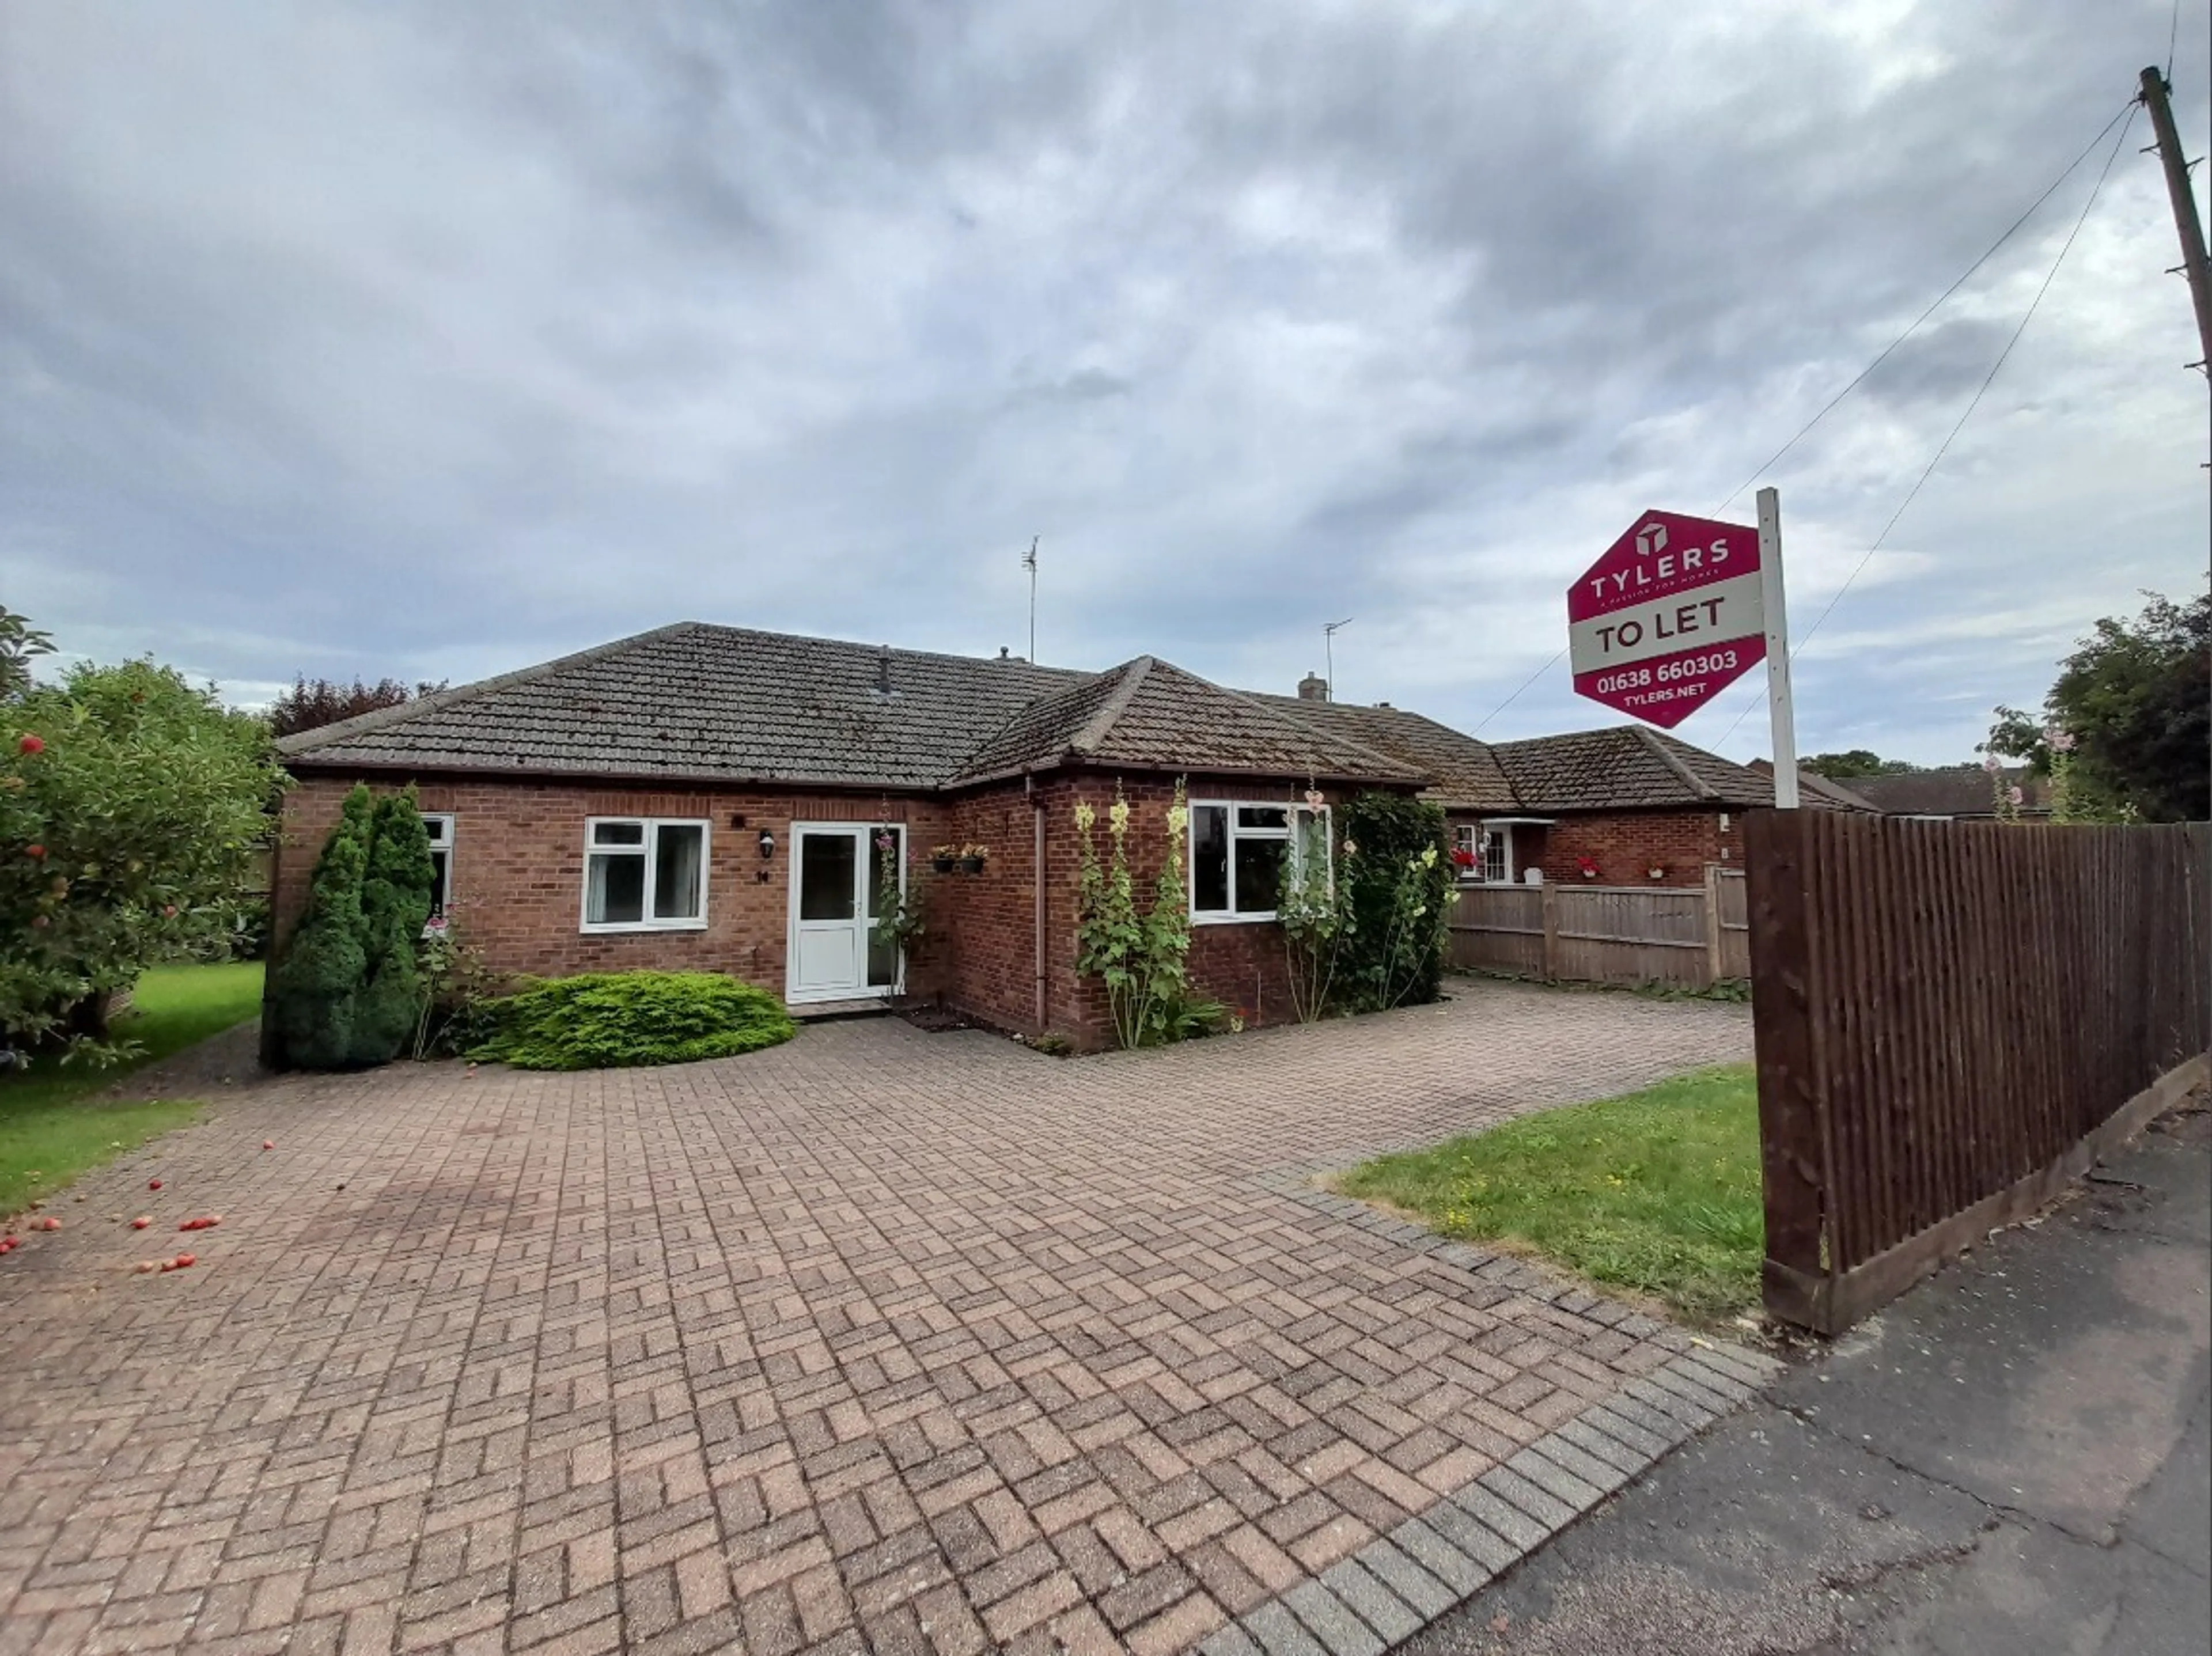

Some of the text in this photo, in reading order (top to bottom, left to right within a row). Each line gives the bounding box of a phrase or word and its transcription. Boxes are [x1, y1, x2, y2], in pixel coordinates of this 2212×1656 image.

[1590, 539, 1729, 598] TYLERS
[1596, 597, 1725, 652] TO LET
[1597, 650, 1738, 694] 01638 660303
[1623, 683, 1707, 708] TYLERS.NET
